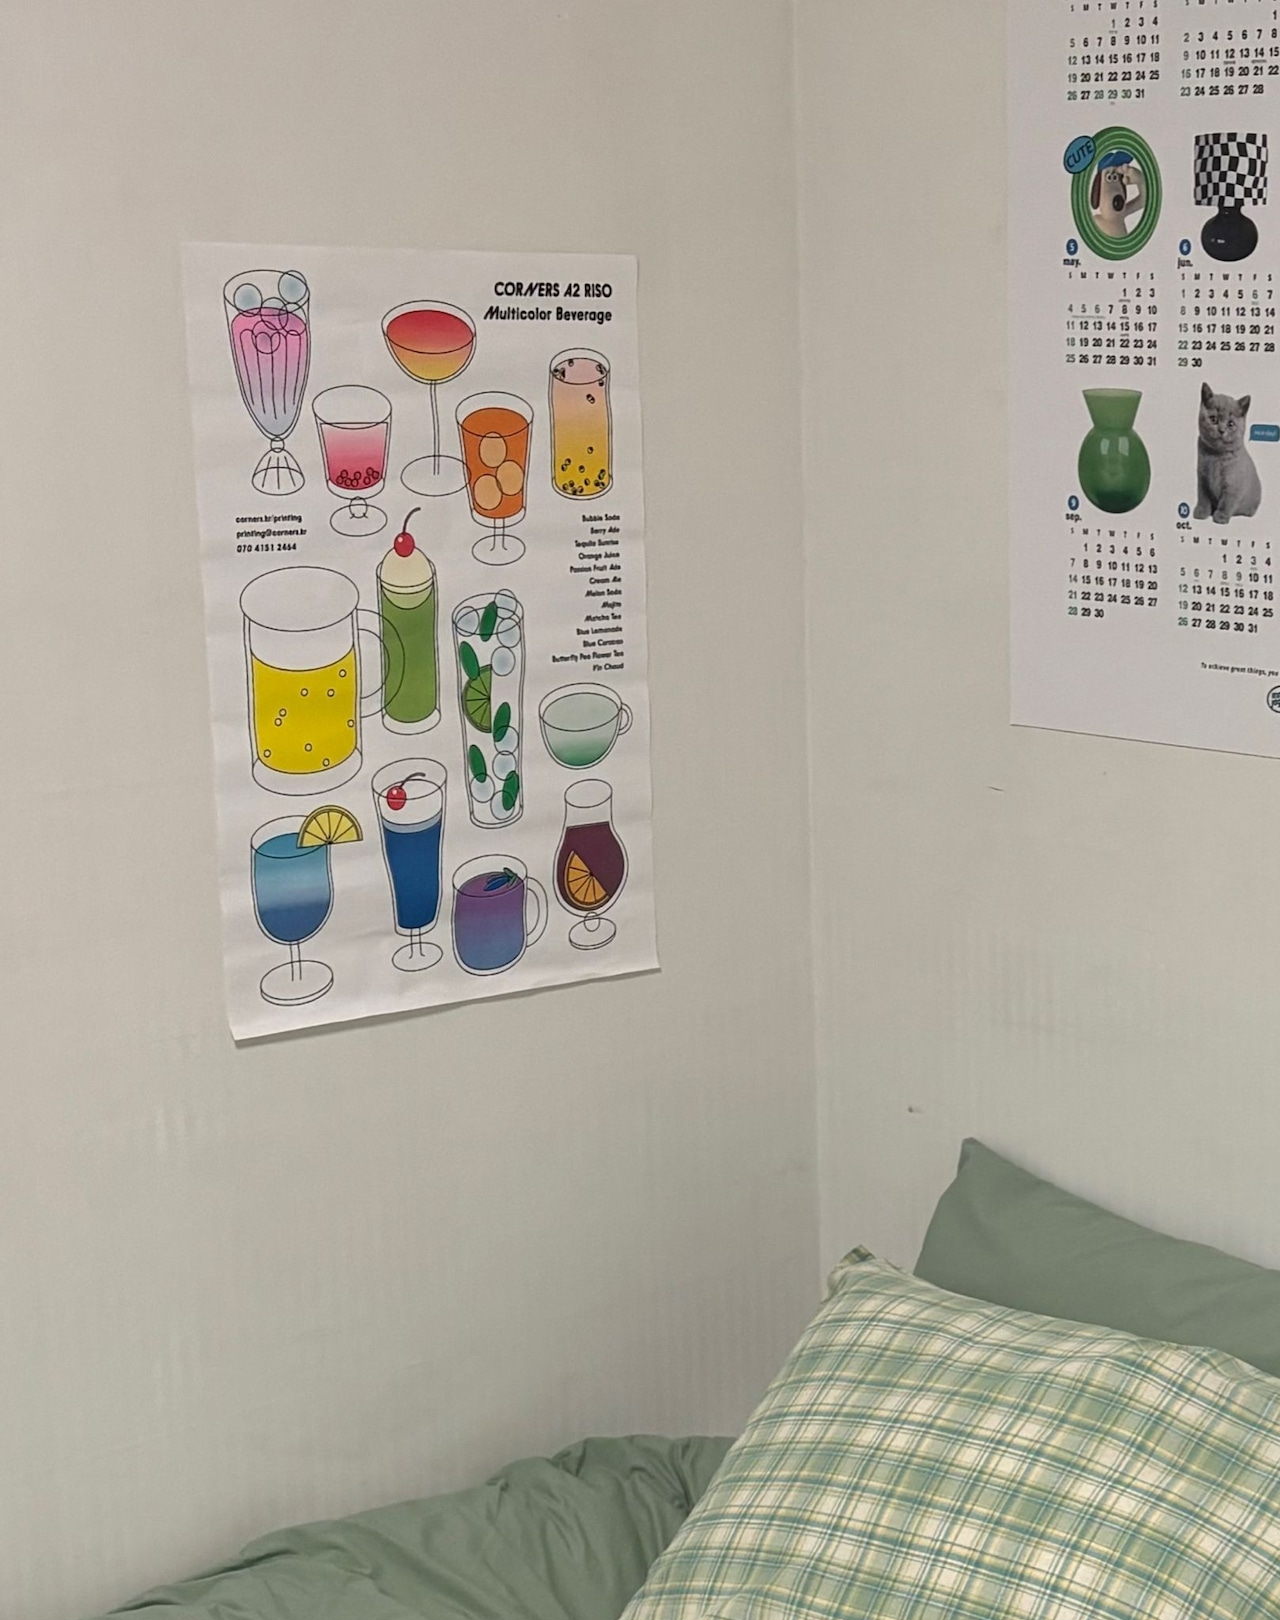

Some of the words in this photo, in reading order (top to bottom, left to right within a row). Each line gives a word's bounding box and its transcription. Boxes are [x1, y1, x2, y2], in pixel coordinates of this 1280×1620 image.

[1068, 56, 1077, 65] 12
[1081, 55, 1091, 65] 13
[1095, 54, 1104, 64] 14
[1109, 54, 1118, 64] 15
[1122, 53, 1132, 63] 16
[1136, 53, 1146, 63] 17
[1150, 52, 1160, 62] 18
[1183, 51, 1189, 60] 9
[1196, 50, 1206, 60] 10
[1210, 49, 1219, 59] 11
[1225, 48, 1235, 59] 12
[1240, 48, 1250, 58] 13
[1254, 47, 1264, 58] 14
[1269, 46, 1279, 57] 15
[1067, 141, 1093, 168] CUTE
[1063, 258, 1081, 268] may.
[1177, 257, 1193, 269] jun.
[494, 281, 560, 297] CORNERS
[563, 283, 580, 297] A2
[584, 283, 612, 298] RISO
[1122, 288, 1127, 298] 1
[1136, 288, 1141, 297] 2
[1149, 288, 1155, 298] 3
[483, 306, 552, 320] Multicolor
[556, 306, 612, 325] Beverage
[1178, 340, 1188, 350] 22
[1192, 340, 1202, 350] 23
[1206, 341, 1216, 350] 24
[1220, 341, 1231, 351] 25
[1235, 341, 1245, 351] 26
[1249, 342, 1260, 352] 27
[1264, 342, 1275, 352] 28
[1079, 354, 1089, 364] 26
[1092, 354, 1102, 364] 27
[1106, 355, 1116, 365] 28
[1120, 355, 1130, 365] 29
[1133, 356, 1144, 365] 30
[1147, 356, 1156, 366] 31
[1066, 512, 1082, 523] sep.
[1176, 521, 1192, 530] oct.
[237, 544, 252, 553] 070
[579, 552, 602, 560] Orange
[1069, 574, 1078, 583] 14
[1082, 575, 1091, 584] 15
[1095, 576, 1104, 586] 16
[1108, 578, 1117, 587] 17
[1121, 579, 1131, 588] 18
[1135, 580, 1144, 589] 19
[1147, 581, 1158, 590] 20
[1179, 601, 1188, 609] 19
[1191, 601, 1202, 611] 20
[1206, 602, 1215, 612] 21
[1219, 604, 1230, 613] 22
[1234, 605, 1244, 615] 23
[1248, 606, 1259, 616] 24
[1262, 608, 1273, 618] 25
